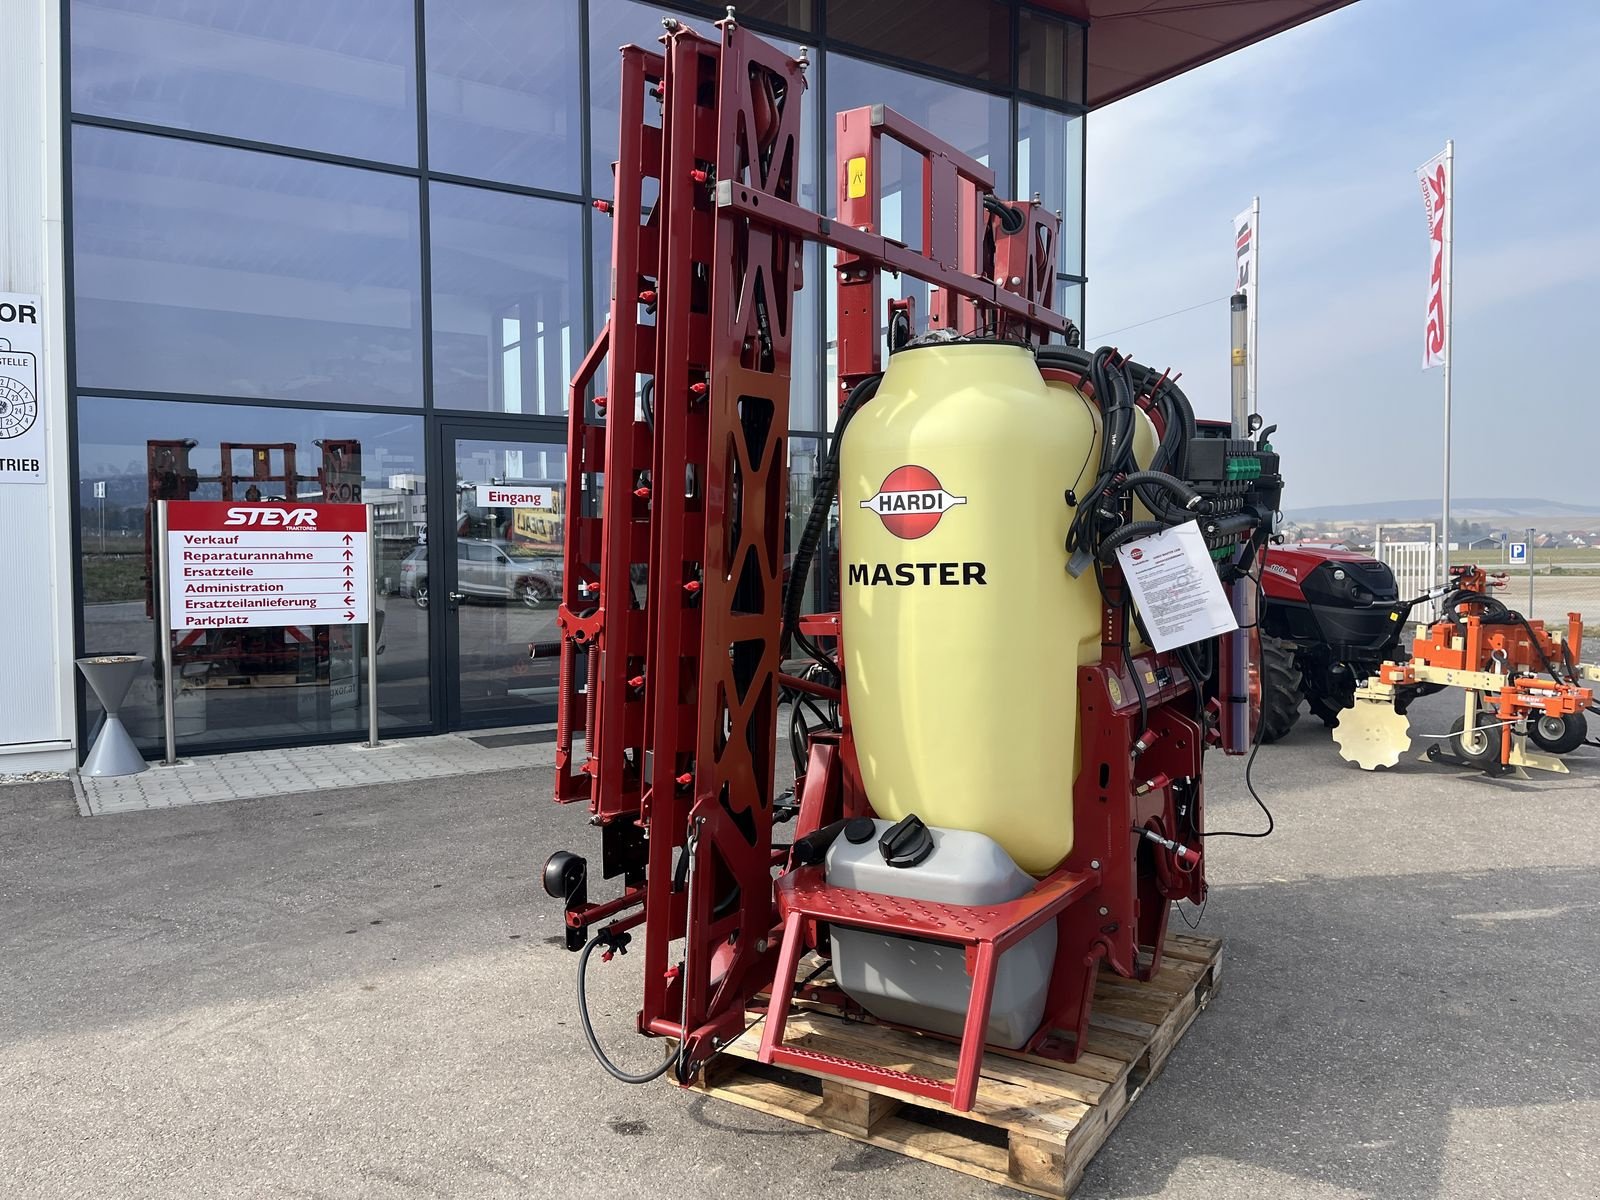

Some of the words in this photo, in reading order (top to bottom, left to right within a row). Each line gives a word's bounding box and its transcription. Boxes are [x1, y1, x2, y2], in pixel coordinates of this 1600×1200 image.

[488, 491, 541, 506] Eingang
[879, 493, 943, 512] HARDI
[223, 507, 318, 526] STEYR
[184, 534, 239, 545] Verkauf
[184, 551, 314, 563] Reparaturannahme
[1513, 546, 1523, 558] P
[184, 567, 253, 577] Ersatzteile
[848, 562, 988, 586] MASTER
[185, 582, 284, 594] Administration
[185, 597, 317, 609] Ersatzteilanlieferung
[185, 615, 249, 627] Parkplatz
